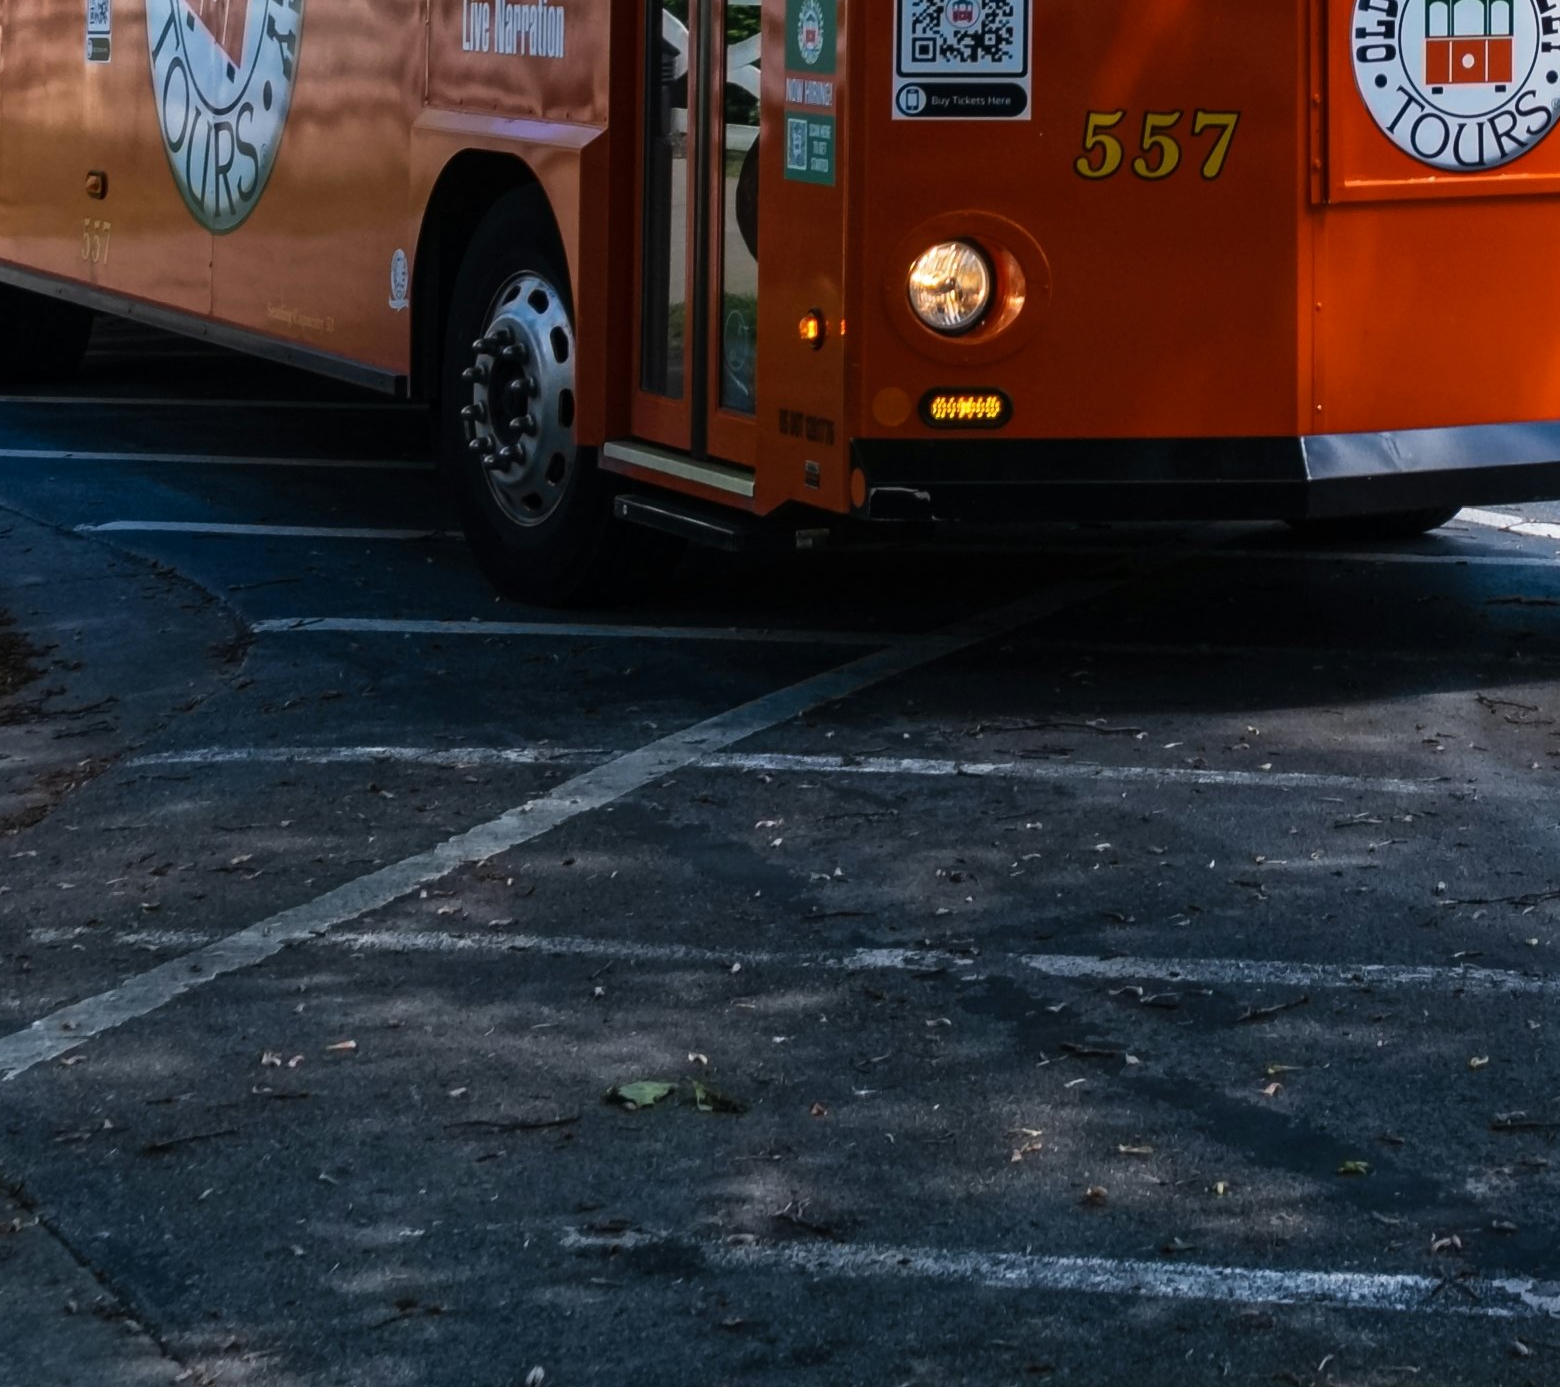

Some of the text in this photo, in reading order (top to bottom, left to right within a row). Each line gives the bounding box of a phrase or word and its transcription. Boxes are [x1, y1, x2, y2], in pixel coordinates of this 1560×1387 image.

[931, 95, 1011, 107] Buy Tickets Here
[1386, 85, 1552, 167] TOURS
[1075, 109, 1242, 183] 557
[81, 218, 111, 265] 557
